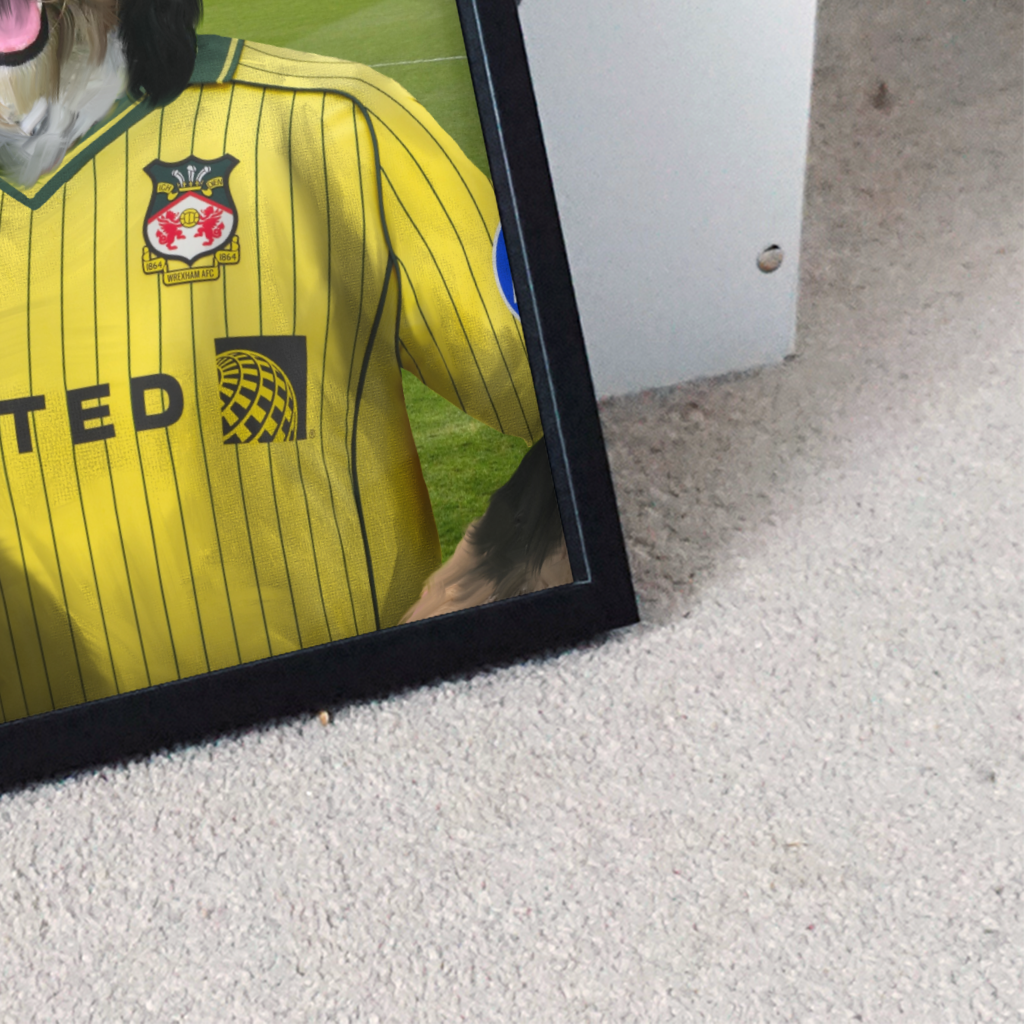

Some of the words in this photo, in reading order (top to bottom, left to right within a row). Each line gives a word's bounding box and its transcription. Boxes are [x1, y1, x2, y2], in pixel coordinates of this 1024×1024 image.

[219, 253, 237, 262] 1864
[146, 260, 163, 271] 1864
[167, 271, 200, 283] WREXHAM
[201, 269, 215, 279] AFC
